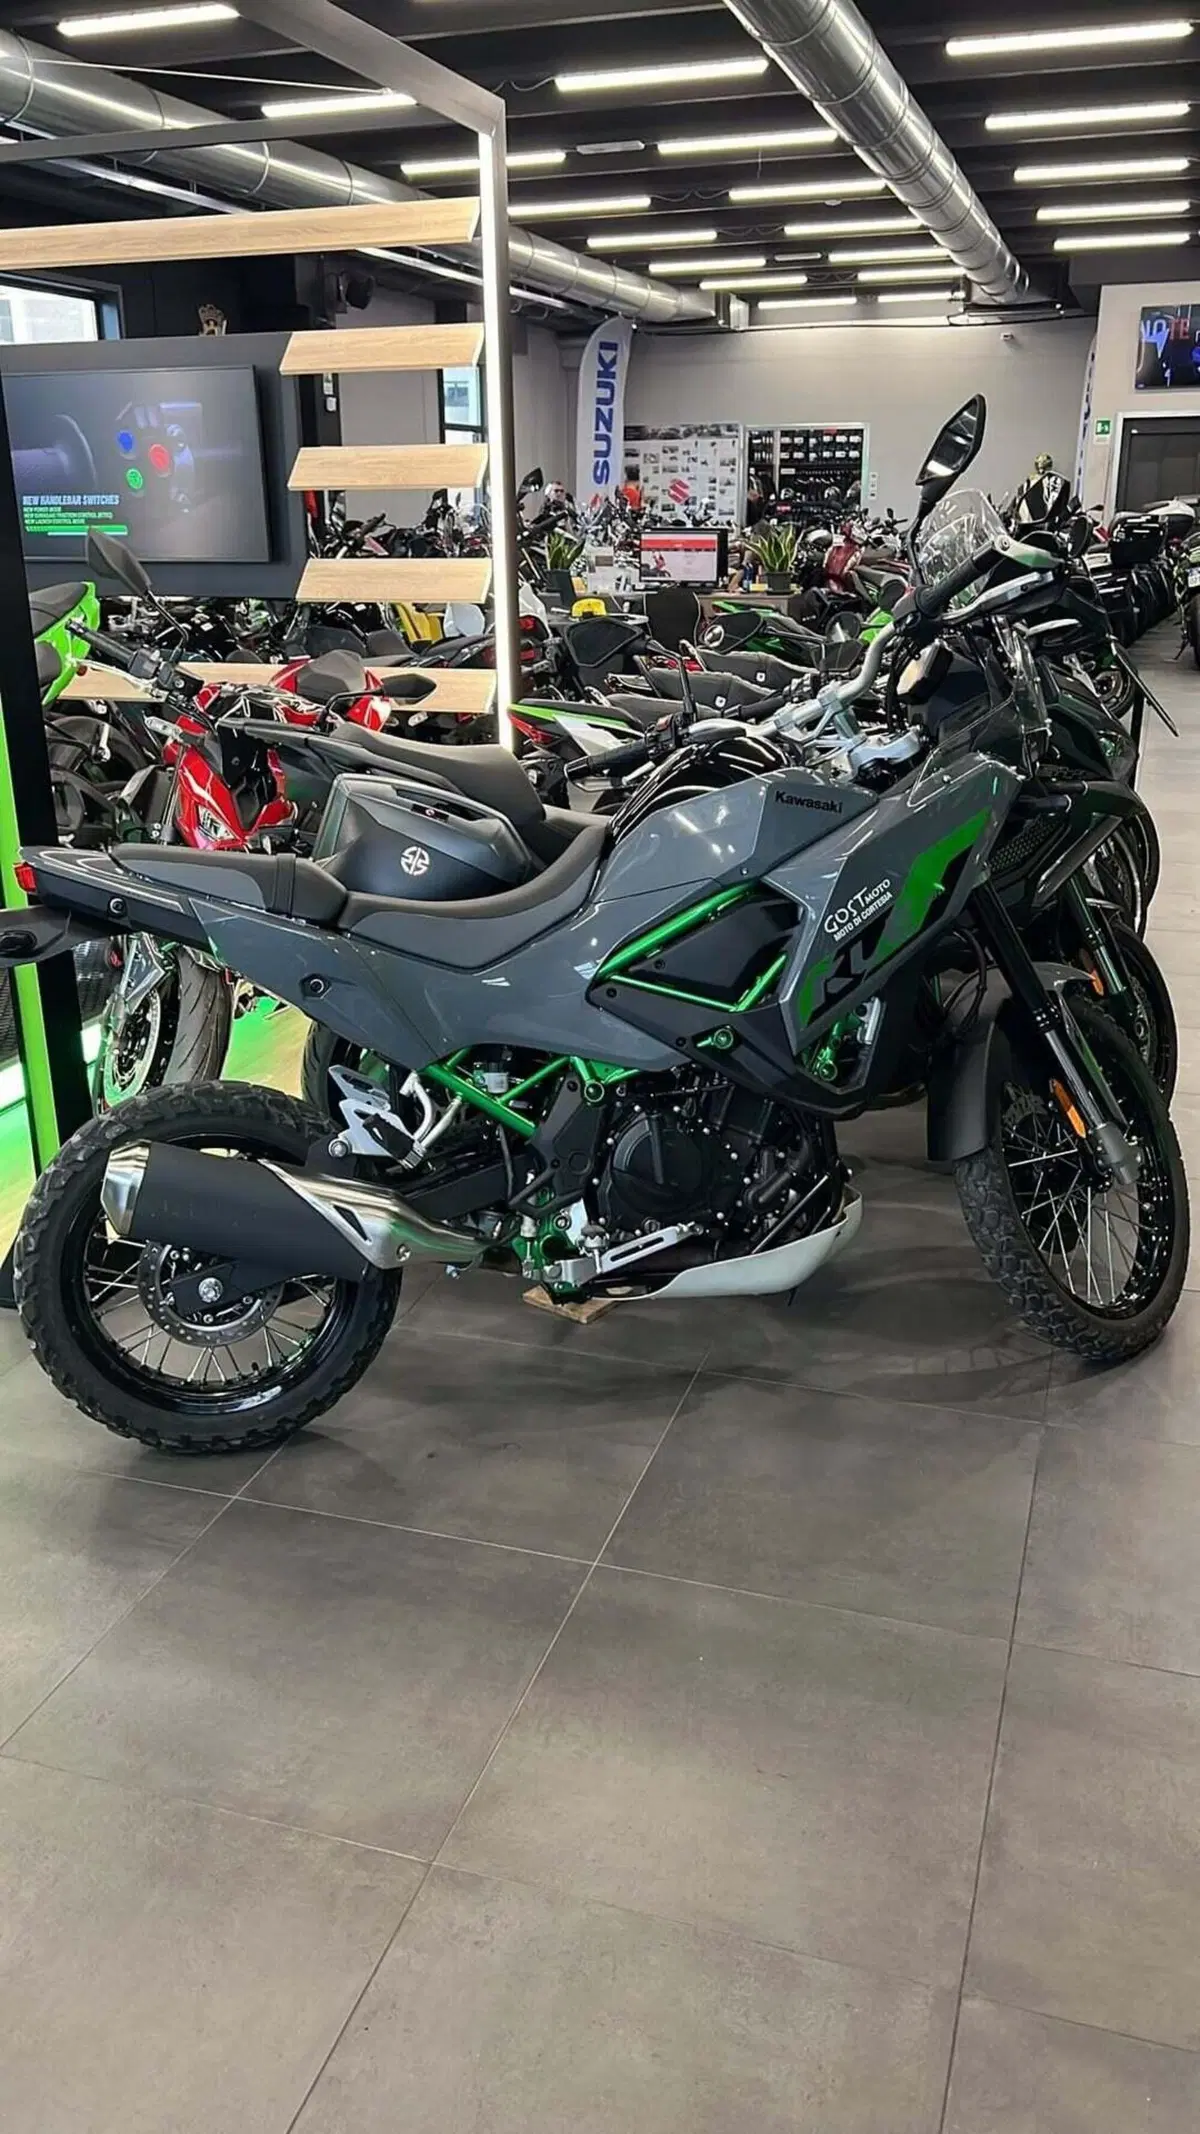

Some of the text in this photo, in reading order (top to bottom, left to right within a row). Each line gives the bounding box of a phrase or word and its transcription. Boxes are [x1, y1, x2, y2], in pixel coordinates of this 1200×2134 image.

[593, 341, 619, 485] SUZUKI
[23, 495, 39, 505] NEW
[83, 495, 120, 505] SWITCHES
[775, 790, 843, 814] Kawasaki
[824, 879, 891, 933] GOST MOTO
[833, 891, 893, 942] MOTO DI CORTESIA
